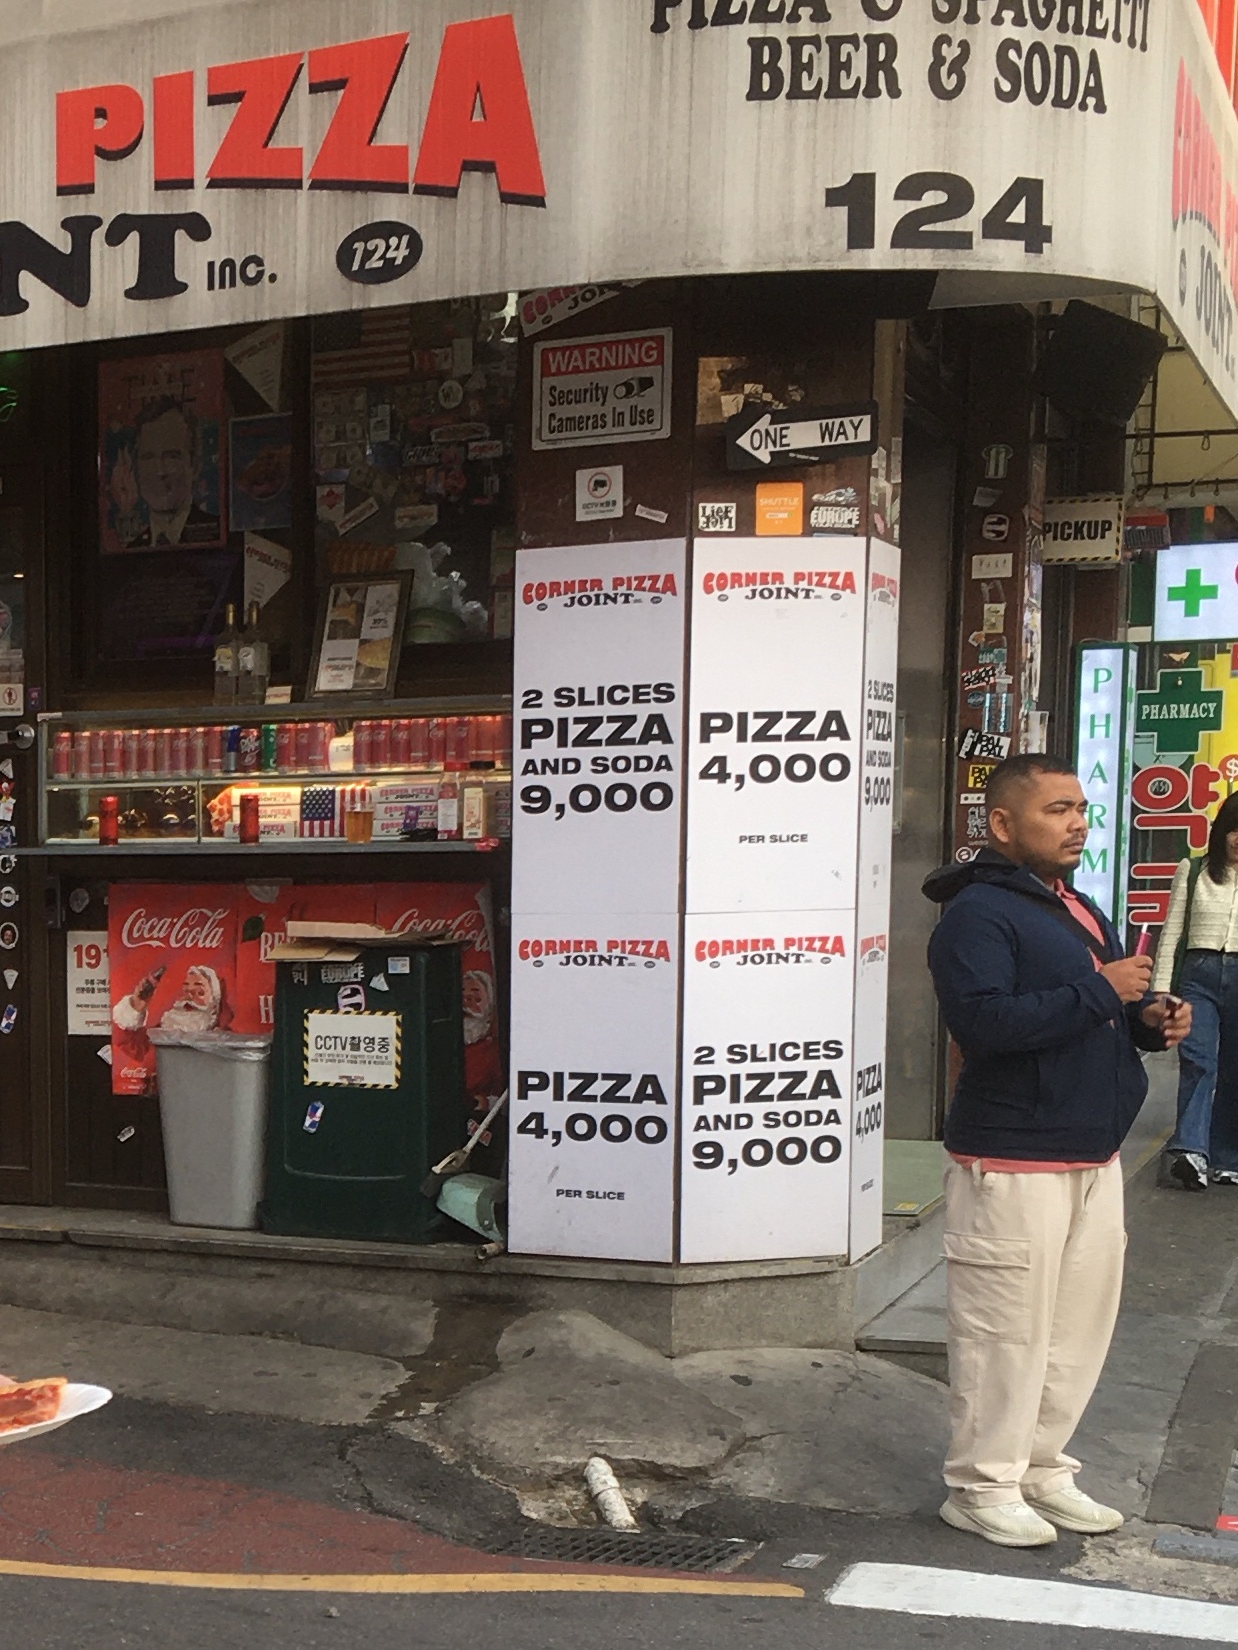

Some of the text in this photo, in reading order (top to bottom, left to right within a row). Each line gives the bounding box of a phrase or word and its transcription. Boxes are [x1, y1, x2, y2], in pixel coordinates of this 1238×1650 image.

[746, 32, 1108, 114] BEER & SODA
[56, 14, 547, 209] PIZZA
[824, 171, 1053, 254] 124
[351, 233, 410, 273] 124
[548, 340, 659, 375] WARNING
[548, 381, 610, 408] Security
[547, 404, 655, 434] Cameras In Use
[749, 418, 865, 451] ONE WAY
[1043, 519, 1113, 542] PICKUP
[522, 573, 678, 605] CORNER PIZZA
[703, 571, 785, 595] CORNER
[793, 570, 857, 595] PIZZA
[744, 587, 815, 600] JOINT
[563, 592, 635, 608] JOINT
[521, 682, 675, 709] 2 SLICES
[867, 679, 894, 704] 2 SLICES
[699, 710, 852, 744] PIZZA
[866, 708, 893, 742] PIZZA
[1141, 702, 1217, 720] PHARMACY
[520, 713, 674, 750] PIZZA
[521, 754, 674, 777] AND SODA
[698, 752, 852, 791] 4,000
[519, 782, 674, 821] 9,000
[864, 777, 891, 812] 9,000
[738, 833, 808, 844] PER SLICE
[518, 938, 671, 963] CORNER PIZZA
[559, 955, 628, 968] JOINT
[694, 937, 775, 962] CORNER
[784, 935, 846, 958] PIZZA
[736, 953, 804, 966] JOINT
[693, 1040, 844, 1065] 2 SLICES
[517, 1070, 668, 1105] PIZZA
[692, 1069, 842, 1106] PIZZA
[856, 1062, 882, 1101] PIZZA
[516, 1111, 668, 1147] 4,000
[693, 1108, 842, 1132] AND SODA
[856, 1102, 882, 1143] 4,000
[692, 1134, 842, 1175] 9,000
[556, 1188, 625, 1201] PER SLICE
